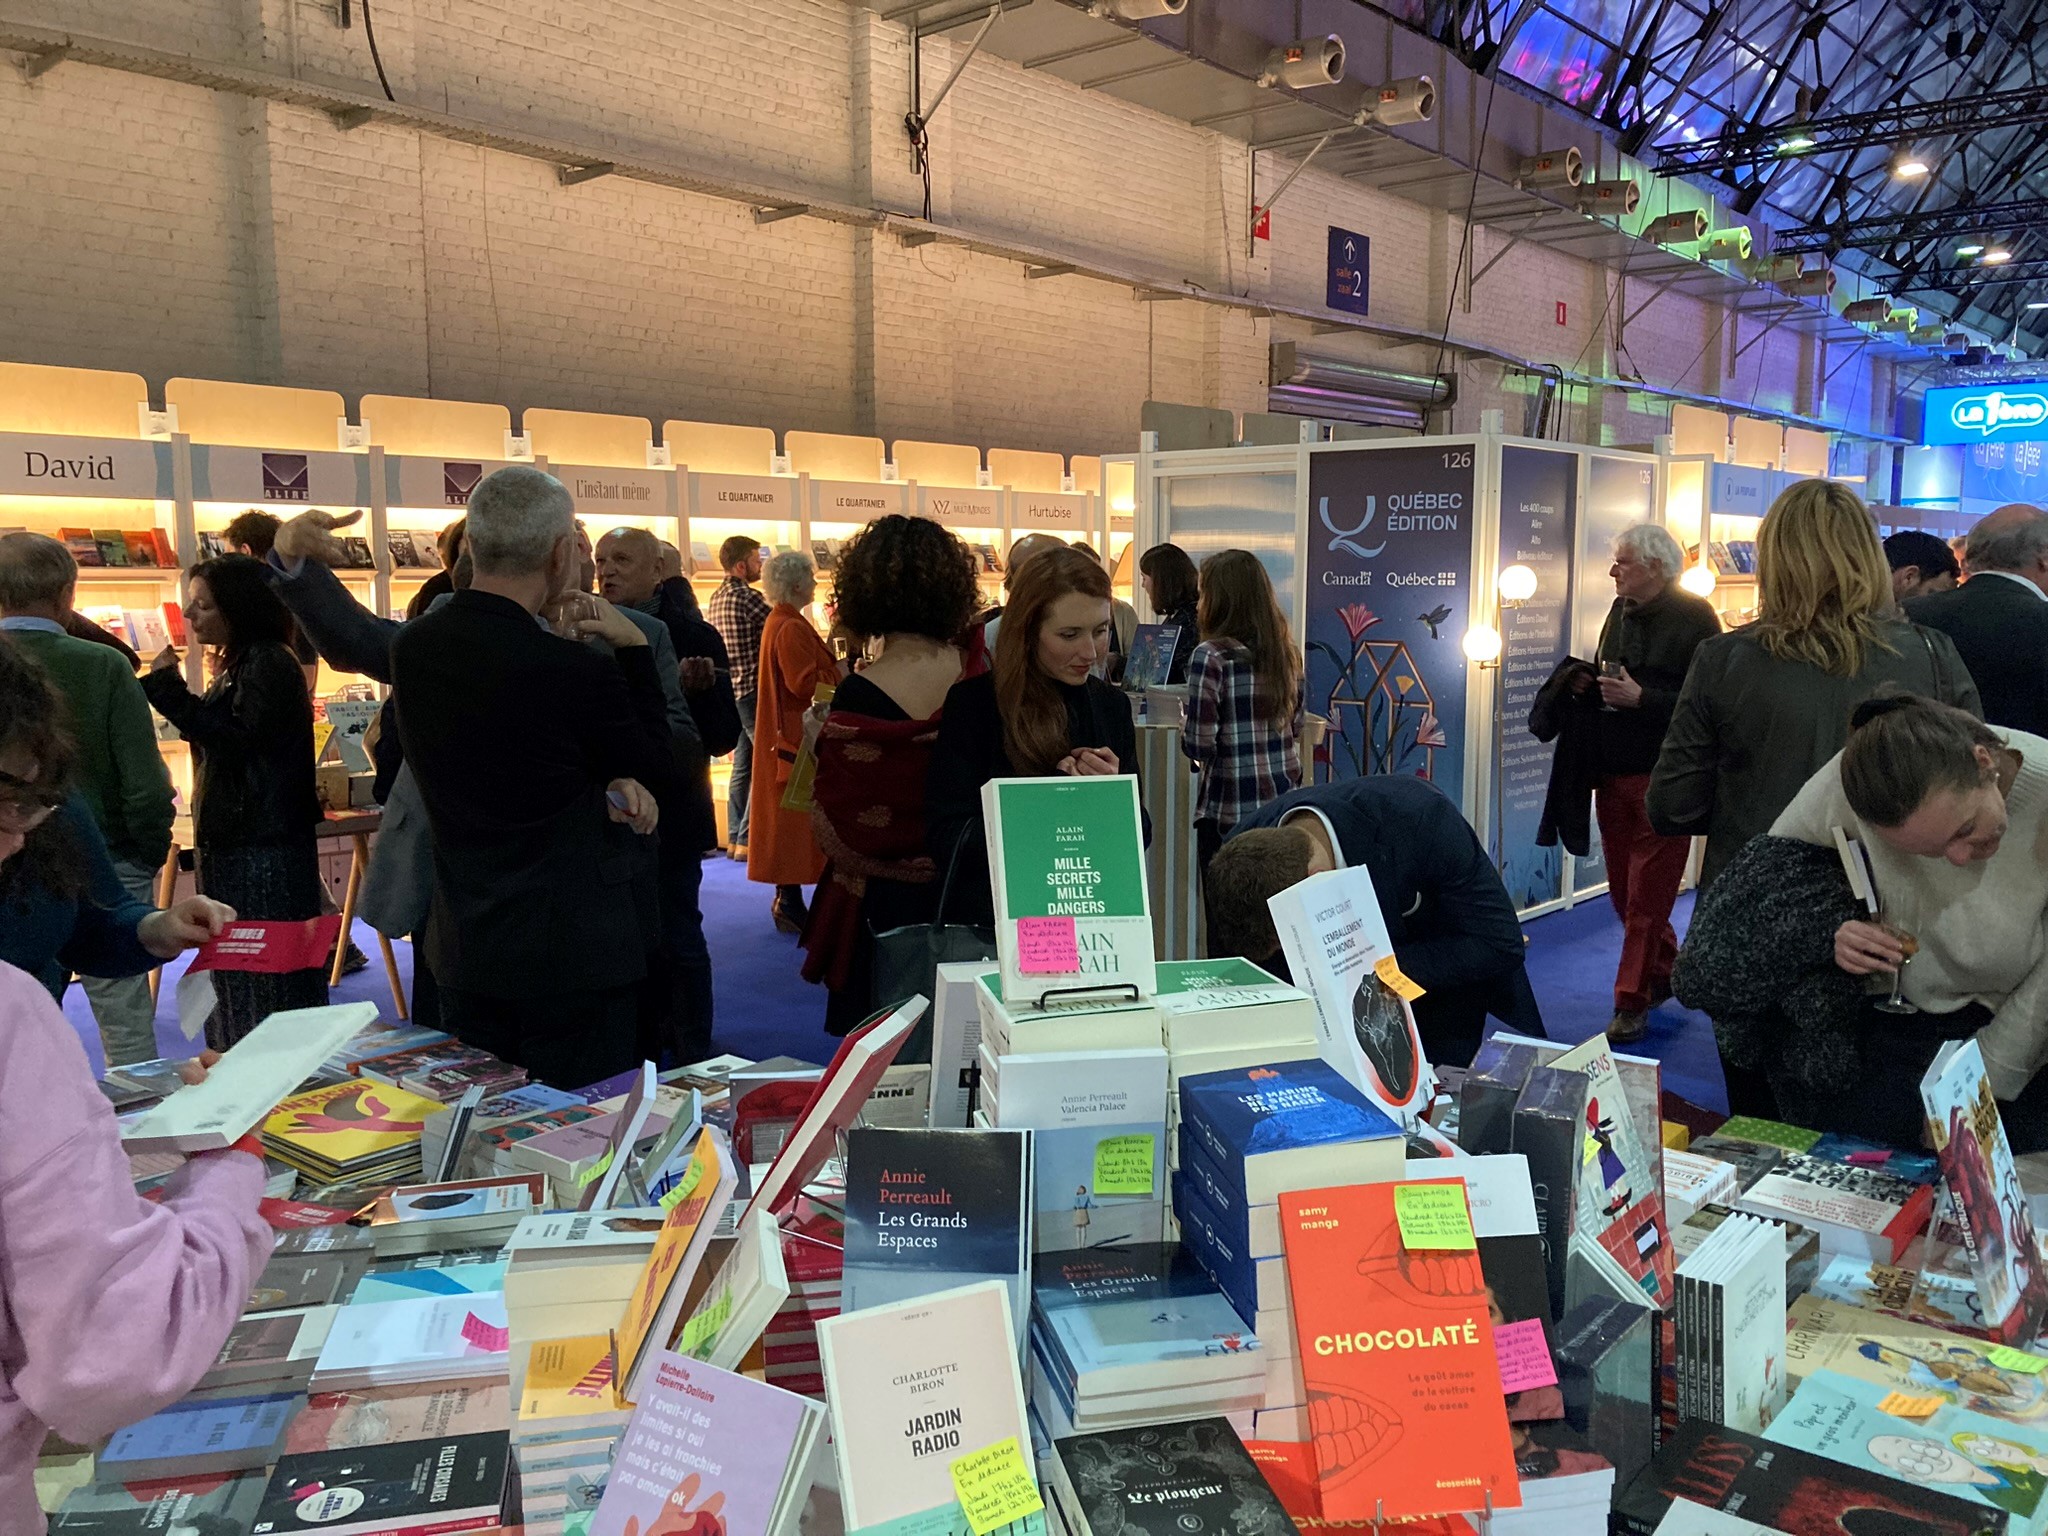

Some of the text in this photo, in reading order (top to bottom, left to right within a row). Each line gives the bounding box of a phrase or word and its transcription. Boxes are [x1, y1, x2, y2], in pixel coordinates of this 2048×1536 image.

[1352, 270, 1362, 297] 2
[24, 451, 115, 481] David
[1442, 452, 1472, 468] 126
[1638, 470, 1652, 484] 126
[264, 488, 309, 499] ALIRE
[576, 479, 651, 501] L'instant même
[718, 491, 775, 504] LE QUARTANIER
[445, 495, 468, 504] ALI
[836, 498, 886, 509] LE QUARTANIER
[932, 499, 951, 515] XYZ
[1387, 491, 1463, 512] QUÉBEC
[1530, 502, 1540, 512] 400
[1028, 501, 1072, 515] Hurtubise
[1387, 512, 1458, 531] ÉDITION
[1322, 571, 1437, 588] Canada Québec
[1055, 826, 1083, 834] ALAIN
[1055, 834, 1085, 843] FARAH
[1054, 857, 1091, 871] MILLE
[1047, 871, 1101, 886] SECRETS
[1057, 886, 1094, 900] MILLE
[1048, 901, 1105, 916] DANGERS
[1315, 899, 1354, 923] VICTOR COURT
[1322, 918, 1365, 945] L'EMBALLEMENT
[1327, 946, 1338, 959] DU
[1337, 937, 1357, 955] MONDE
[1061, 1092, 1128, 1104] Annie Perreault
[1238, 1086, 1319, 1103] LES MARINS
[1268, 1092, 1319, 1104] SAVENT
[1060, 1102, 1127, 1115] Valencia Palace
[1252, 1104, 1279, 1113] PAS
[879, 1168, 926, 1185] Annie
[879, 1188, 952, 1205] Perreault
[878, 1211, 968, 1228] Les Grands
[1298, 1206, 1329, 1219] samy
[1300, 1218, 1339, 1231] manga
[877, 1232, 938, 1253] Espaces
[1070, 1274, 1158, 1290] Les Grands
[1074, 1285, 1135, 1298] Espaces
[1314, 1319, 1480, 1356] CHOCOLATÉ
[660, 1361, 690, 1382] Michelle
[892, 1362, 959, 1387] CHARLOTTE
[1408, 1370, 1476, 1384] Le goût amer
[655, 1373, 716, 1404] Lapierre-Dallaire
[910, 1378, 946, 1394] BIRON
[1412, 1384, 1477, 1397] de la culture
[647, 1393, 711, 1429] Y avait-il des
[1423, 1401, 1470, 1413] du cacao
[639, 1411, 706, 1449] limites si oui
[904, 1407, 963, 1438] JARDIN
[911, 1430, 961, 1458] RADIO
[438, 1445, 458, 1467] FILLES
[631, 1430, 723, 1477] je les ai franchies
[955, 1446, 1015, 1477] Charlotte BIRON
[625, 1450, 686, 1484] mais c'était
[617, 1470, 687, 1507] par amour ok
[959, 1477, 974, 1489] En
[1435, 1477, 1482, 1490] écosociété
[1127, 1484, 1223, 1505] Le plongeur
